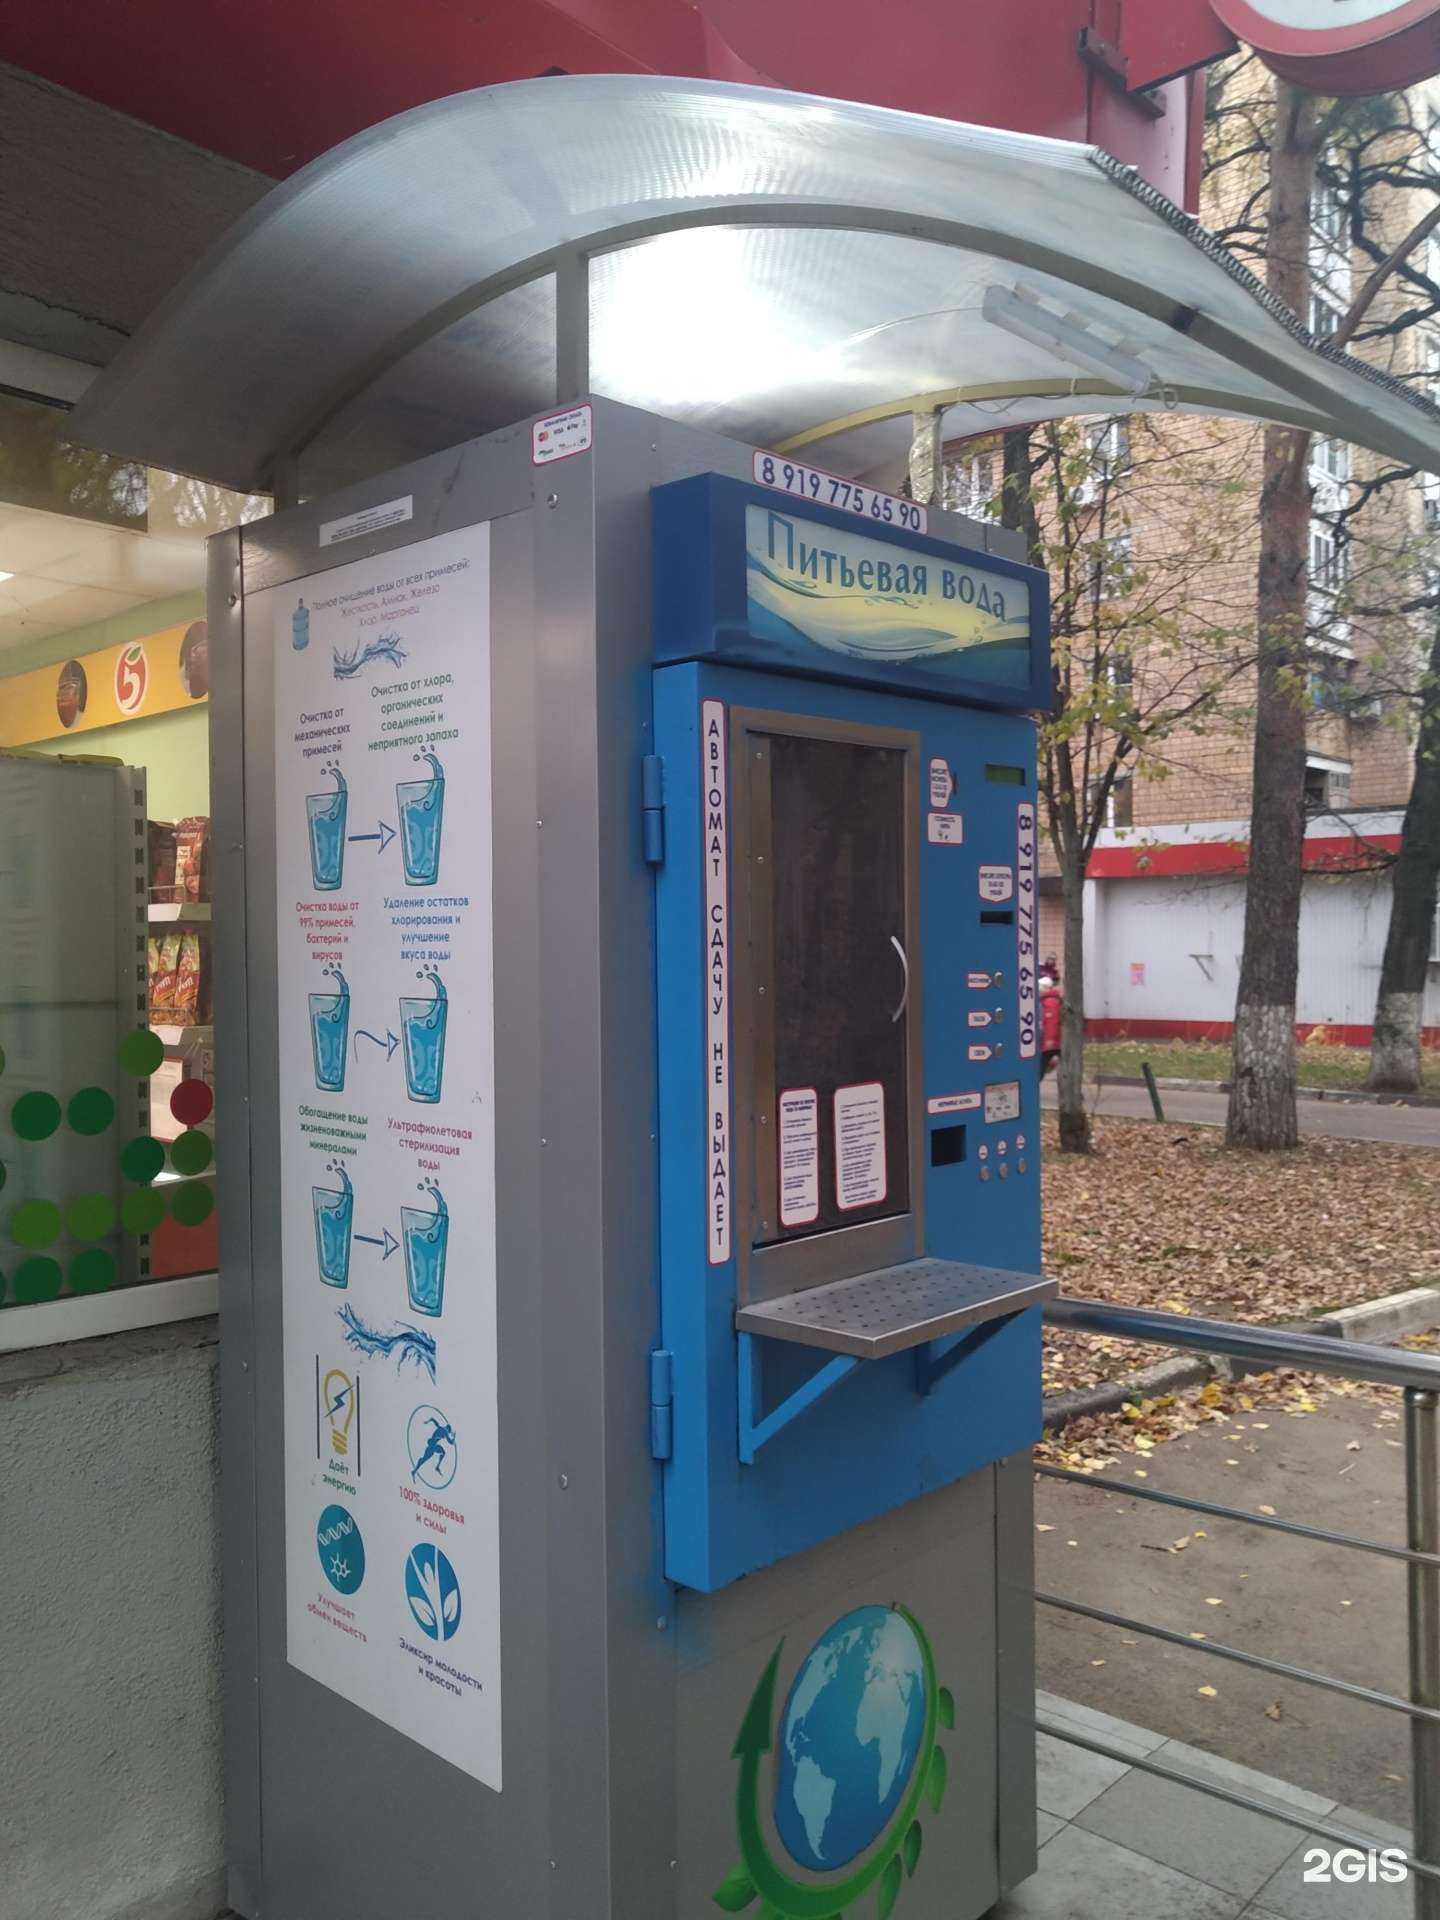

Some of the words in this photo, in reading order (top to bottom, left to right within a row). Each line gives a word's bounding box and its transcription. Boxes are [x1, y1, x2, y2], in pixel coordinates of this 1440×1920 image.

[762, 457, 776, 485] 8
[783, 464, 820, 498] 919
[828, 479, 864, 513] 775
[871, 498, 892, 522] 65
[900, 507, 921, 531] 90
[767, 512, 928, 595] Питьевая
[942, 569, 1007, 622] вода
[371, 682, 409, 698] Очистка
[410, 680, 421, 689] от
[423, 673, 455, 688] хлора,
[381, 694, 444, 715] органических
[300, 709, 333, 724] Очистка
[335, 708, 345, 717] от
[381, 710, 436, 731] соединений
[437, 713, 444, 722] и
[295, 724, 350, 742] механических
[368, 734, 423, 751] неприятного
[425, 729, 459, 742] запаха
[303, 740, 343, 758] примесей
[708, 719, 723, 876] АВТОМАТ
[1020, 814, 1032, 831] 8
[1019, 842, 1033, 893] 919
[296, 901, 327, 912] Очистка
[328, 902, 348, 912] воды
[350, 902, 359, 911] от
[383, 896, 425, 909] Удаление
[427, 895, 469, 908] остатков
[391, 914, 452, 928] хлорирования
[1019, 905, 1033, 956] 775
[306, 932, 342, 946] бактерий
[401, 932, 450, 945] улучшение
[312, 951, 343, 962] вирусов
[400, 951, 426, 962] вкуса
[427, 950, 451, 961] воды
[711, 905, 724, 1015] СДАЧУ
[1020, 968, 1034, 1000] 65
[1020, 1012, 1034, 1045] 90
[714, 1043, 723, 1084] НЕ
[299, 1104, 347, 1122] Обогащение
[348, 1113, 368, 1125] воды
[387, 1117, 472, 1140] Ультрафиолетовая
[309, 1140, 357, 1156] минералами
[399, 1138, 461, 1156] стерилизация
[417, 1158, 440, 1171] воды
[713, 1112, 726, 1246] ВЫДАЕТ
[328, 1458, 349, 1476] Даёт
[322, 1474, 357, 1497] энергию
[400, 1486, 421, 1507] 100%
[422, 1499, 465, 1525] здоровья
[415, 1512, 422, 1523] и
[424, 1517, 448, 1535] силы
[399, 1637, 434, 1665] Эликсир
[435, 1657, 483, 1692] молодости
[417, 1665, 424, 1675] и
[424, 1668, 463, 1697] красоты
